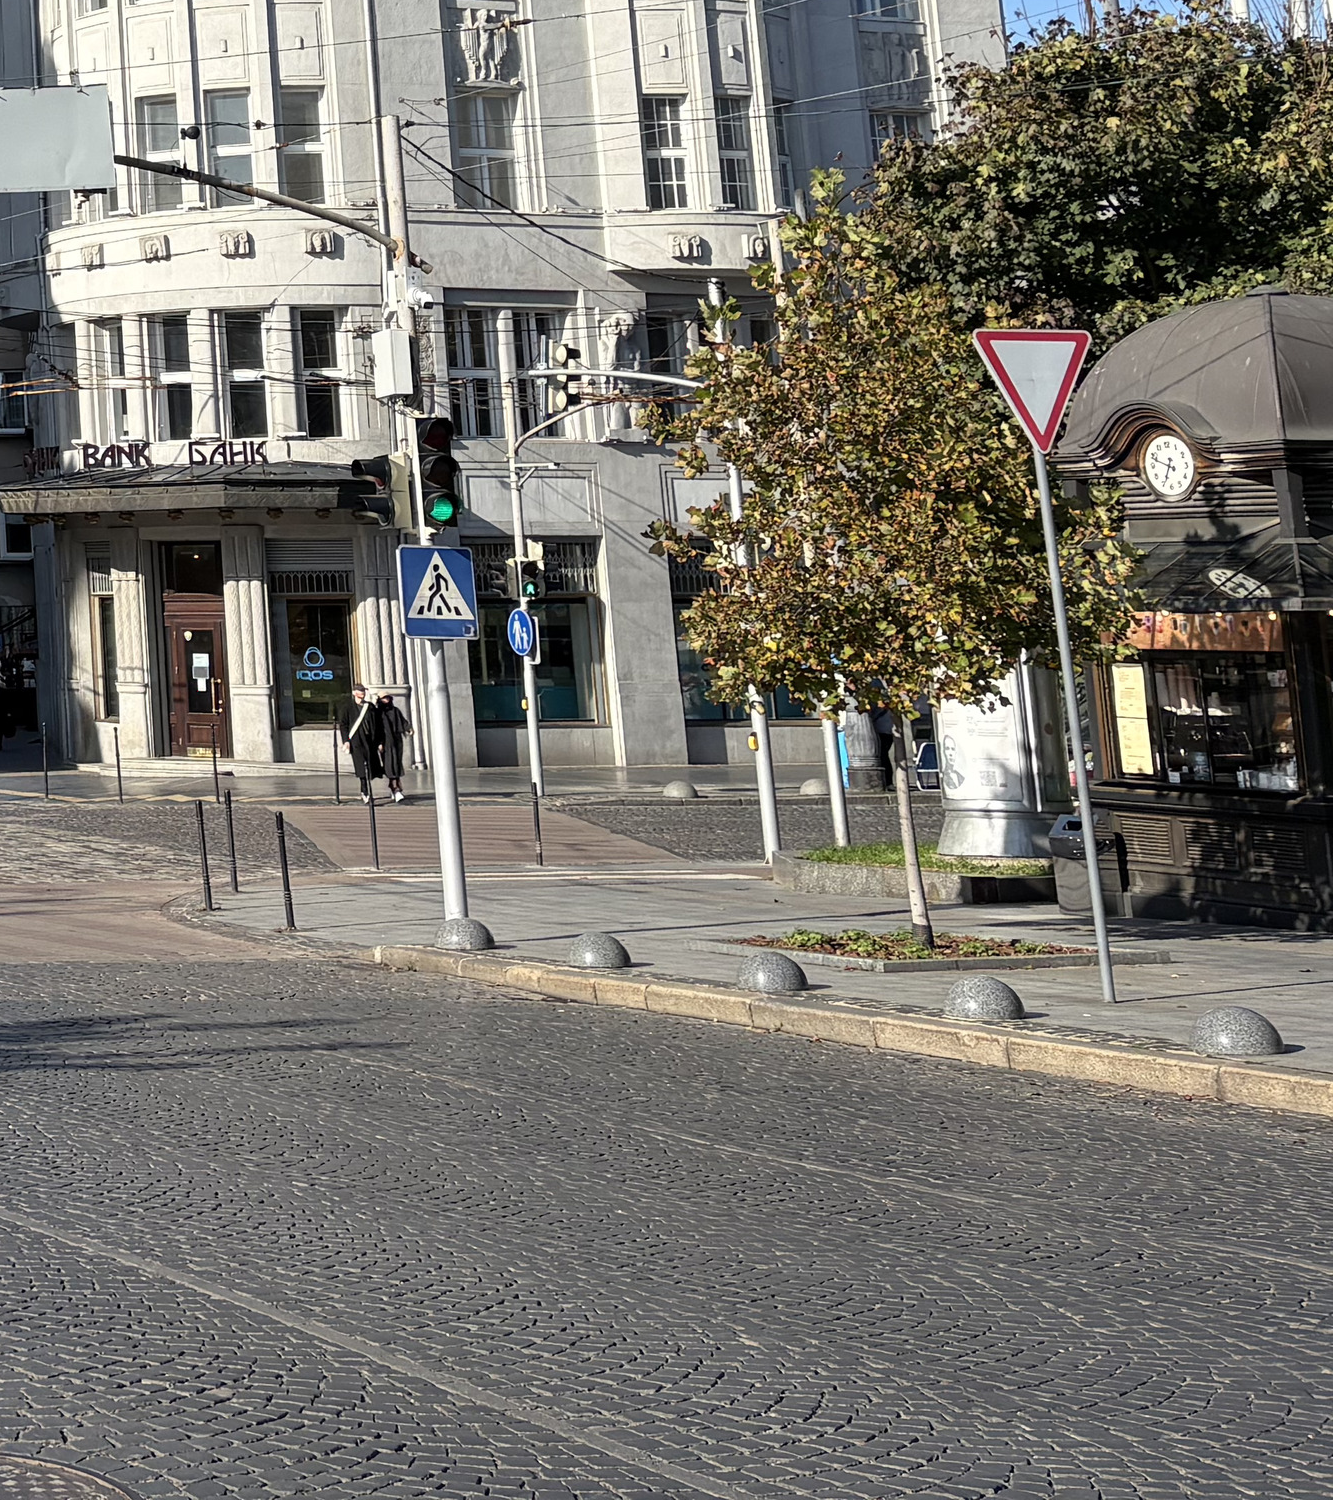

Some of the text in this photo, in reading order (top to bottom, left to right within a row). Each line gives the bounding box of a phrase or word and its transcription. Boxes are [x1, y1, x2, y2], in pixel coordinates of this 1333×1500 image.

[83, 443, 153, 468] BANK
[188, 440, 269, 465] БАНК
[296, 670, 334, 681] IQOS
